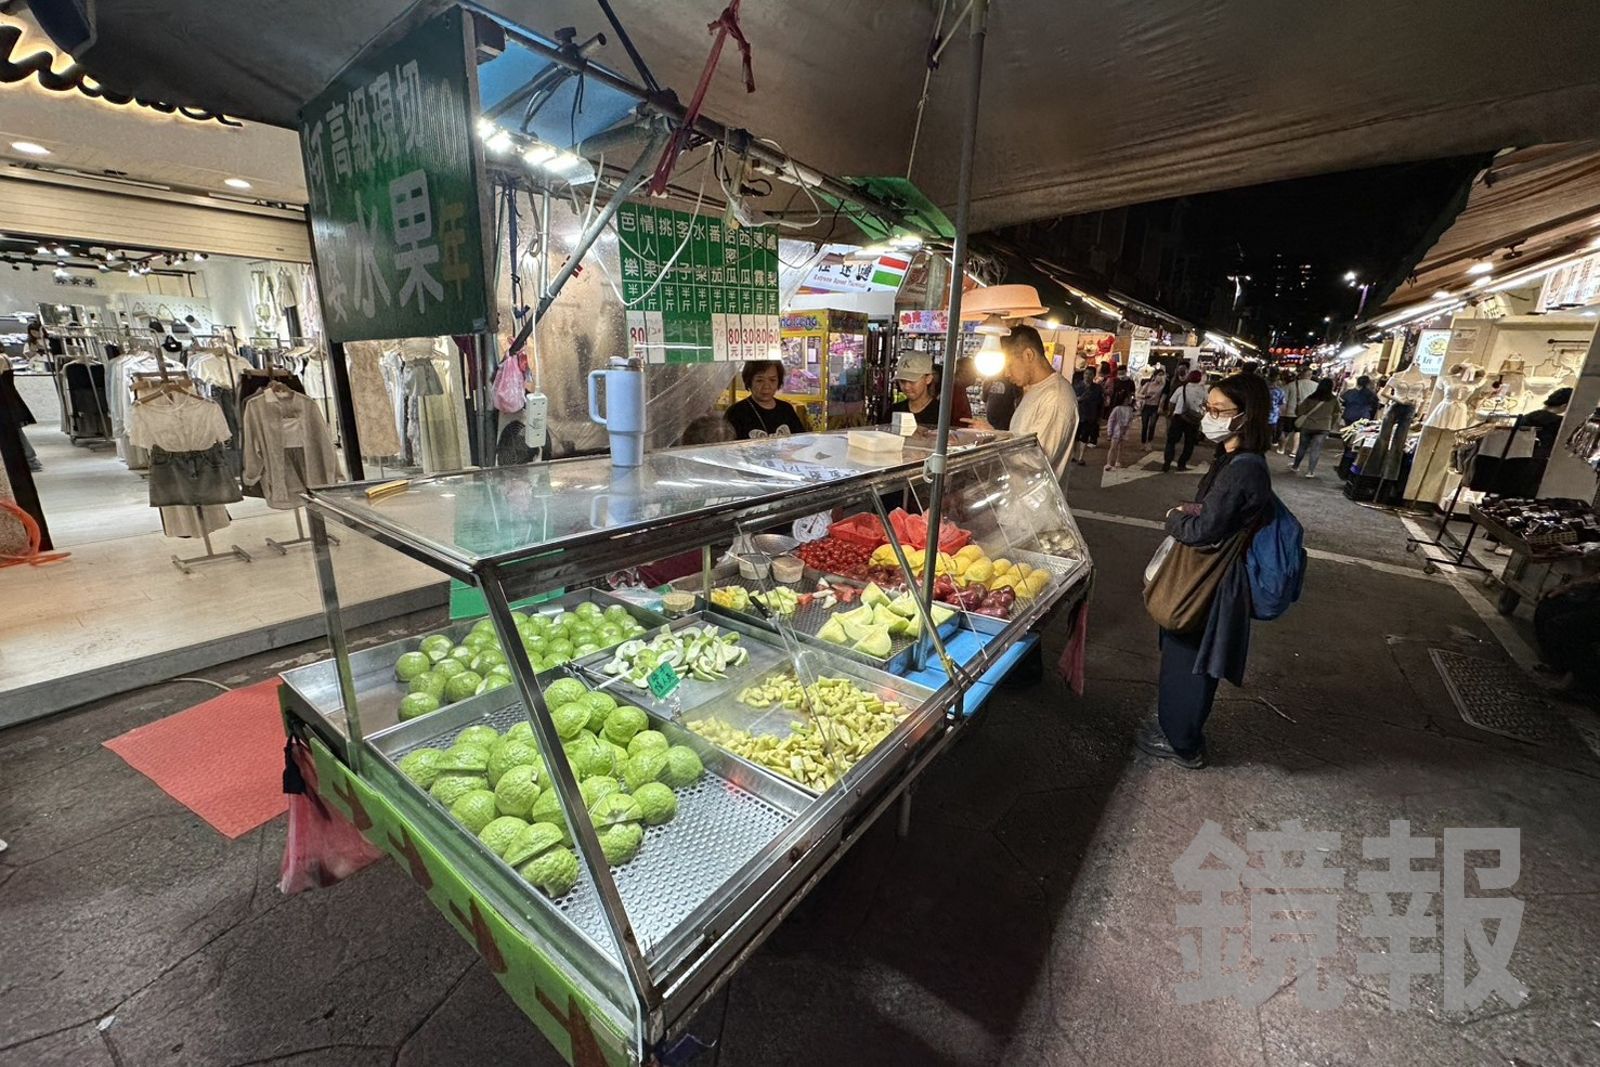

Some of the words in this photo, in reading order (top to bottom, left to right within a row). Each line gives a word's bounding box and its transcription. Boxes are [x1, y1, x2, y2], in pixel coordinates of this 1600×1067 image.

[326, 59, 426, 183] 高級現切
[354, 168, 444, 318] 水果
[620, 211, 640, 277] 芭樂
[640, 214, 657, 278] 情人果
[676, 220, 691, 281] 李子
[693, 223, 708, 282] 水梨
[725, 228, 738, 284] 哈密瓜
[739, 229, 752, 285] 西瓜
[665, 286, 675, 311] 半斤
[681, 287, 692, 312] 半斤
[697, 287, 708, 312] 半斤
[713, 288, 723, 313] 半斤
[728, 289, 737, 313] 半斤
[742, 289, 751, 313] 半斤
[755, 291, 764, 314] 半斤
[768, 292, 777, 315] 半斤
[728, 328, 740, 345] 80
[742, 328, 754, 345] 30
[755, 328, 767, 344] 80
[730, 346, 740, 356] 元
[743, 346, 753, 356] 元
